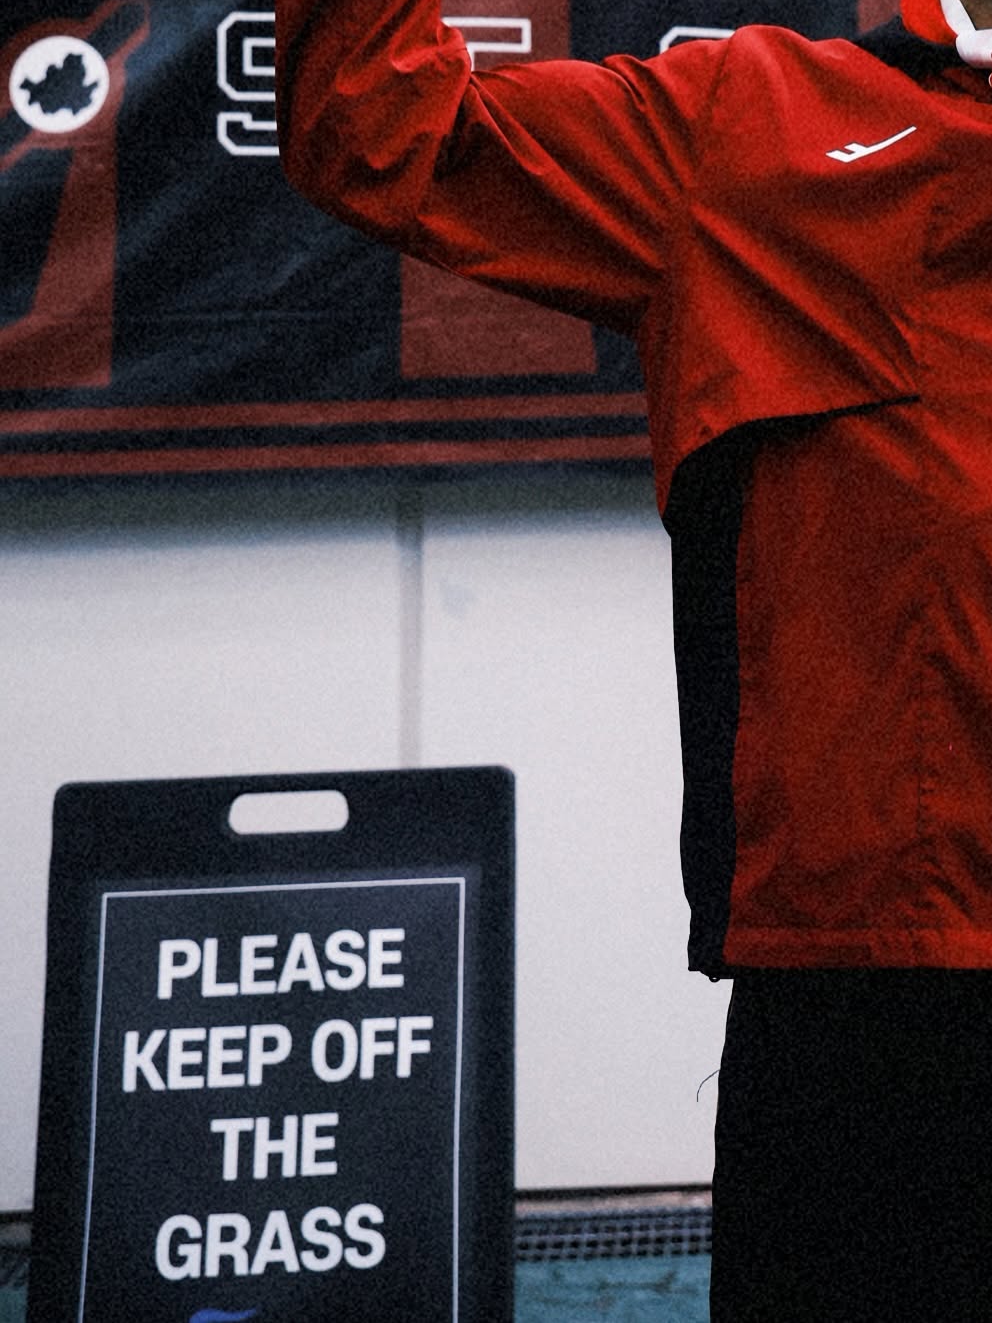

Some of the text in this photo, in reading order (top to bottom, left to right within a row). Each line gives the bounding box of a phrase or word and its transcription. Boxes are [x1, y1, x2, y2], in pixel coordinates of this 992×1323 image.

[157, 928, 405, 1000] PLEASE
[122, 1015, 434, 1093] KEEP OFF
[210, 1112, 339, 1181] THE
[155, 1203, 387, 1281] GRASS
